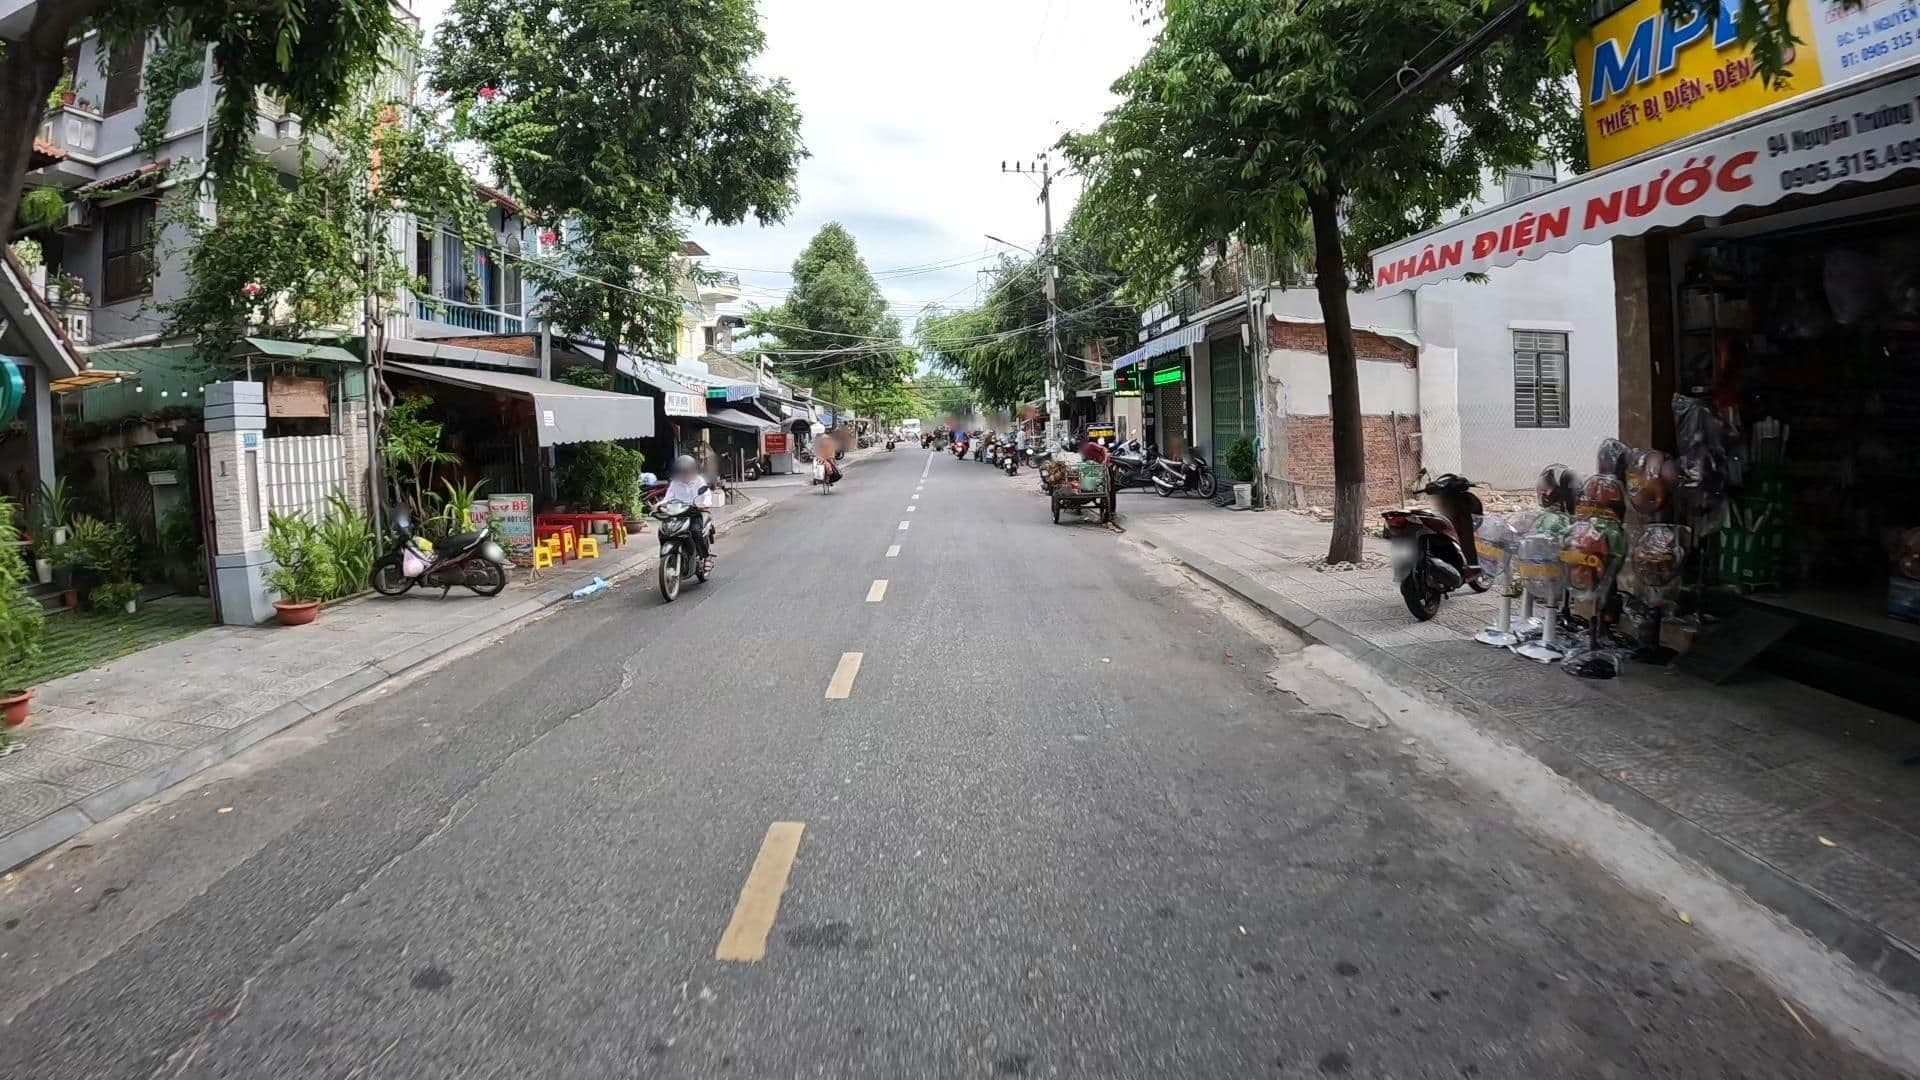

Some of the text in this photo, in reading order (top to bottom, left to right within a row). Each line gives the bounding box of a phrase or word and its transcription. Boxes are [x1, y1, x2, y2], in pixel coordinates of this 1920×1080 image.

[1856, 23, 1871, 40] 94
[1861, 40, 1889, 61] 0905
[1890, 31, 1913, 50] 315
[1597, 100, 1639, 137] THIẾT
[1643, 94, 1663, 121] BỊ
[1664, 78, 1703, 110] ĐIỆN
[1713, 58, 1753, 90] ĐÈN
[1767, 132, 1789, 158] 94
[1791, 115, 1851, 151] Nguyễn
[1376, 151, 1760, 288] NHÂN ĐIỆN NƯỚC
